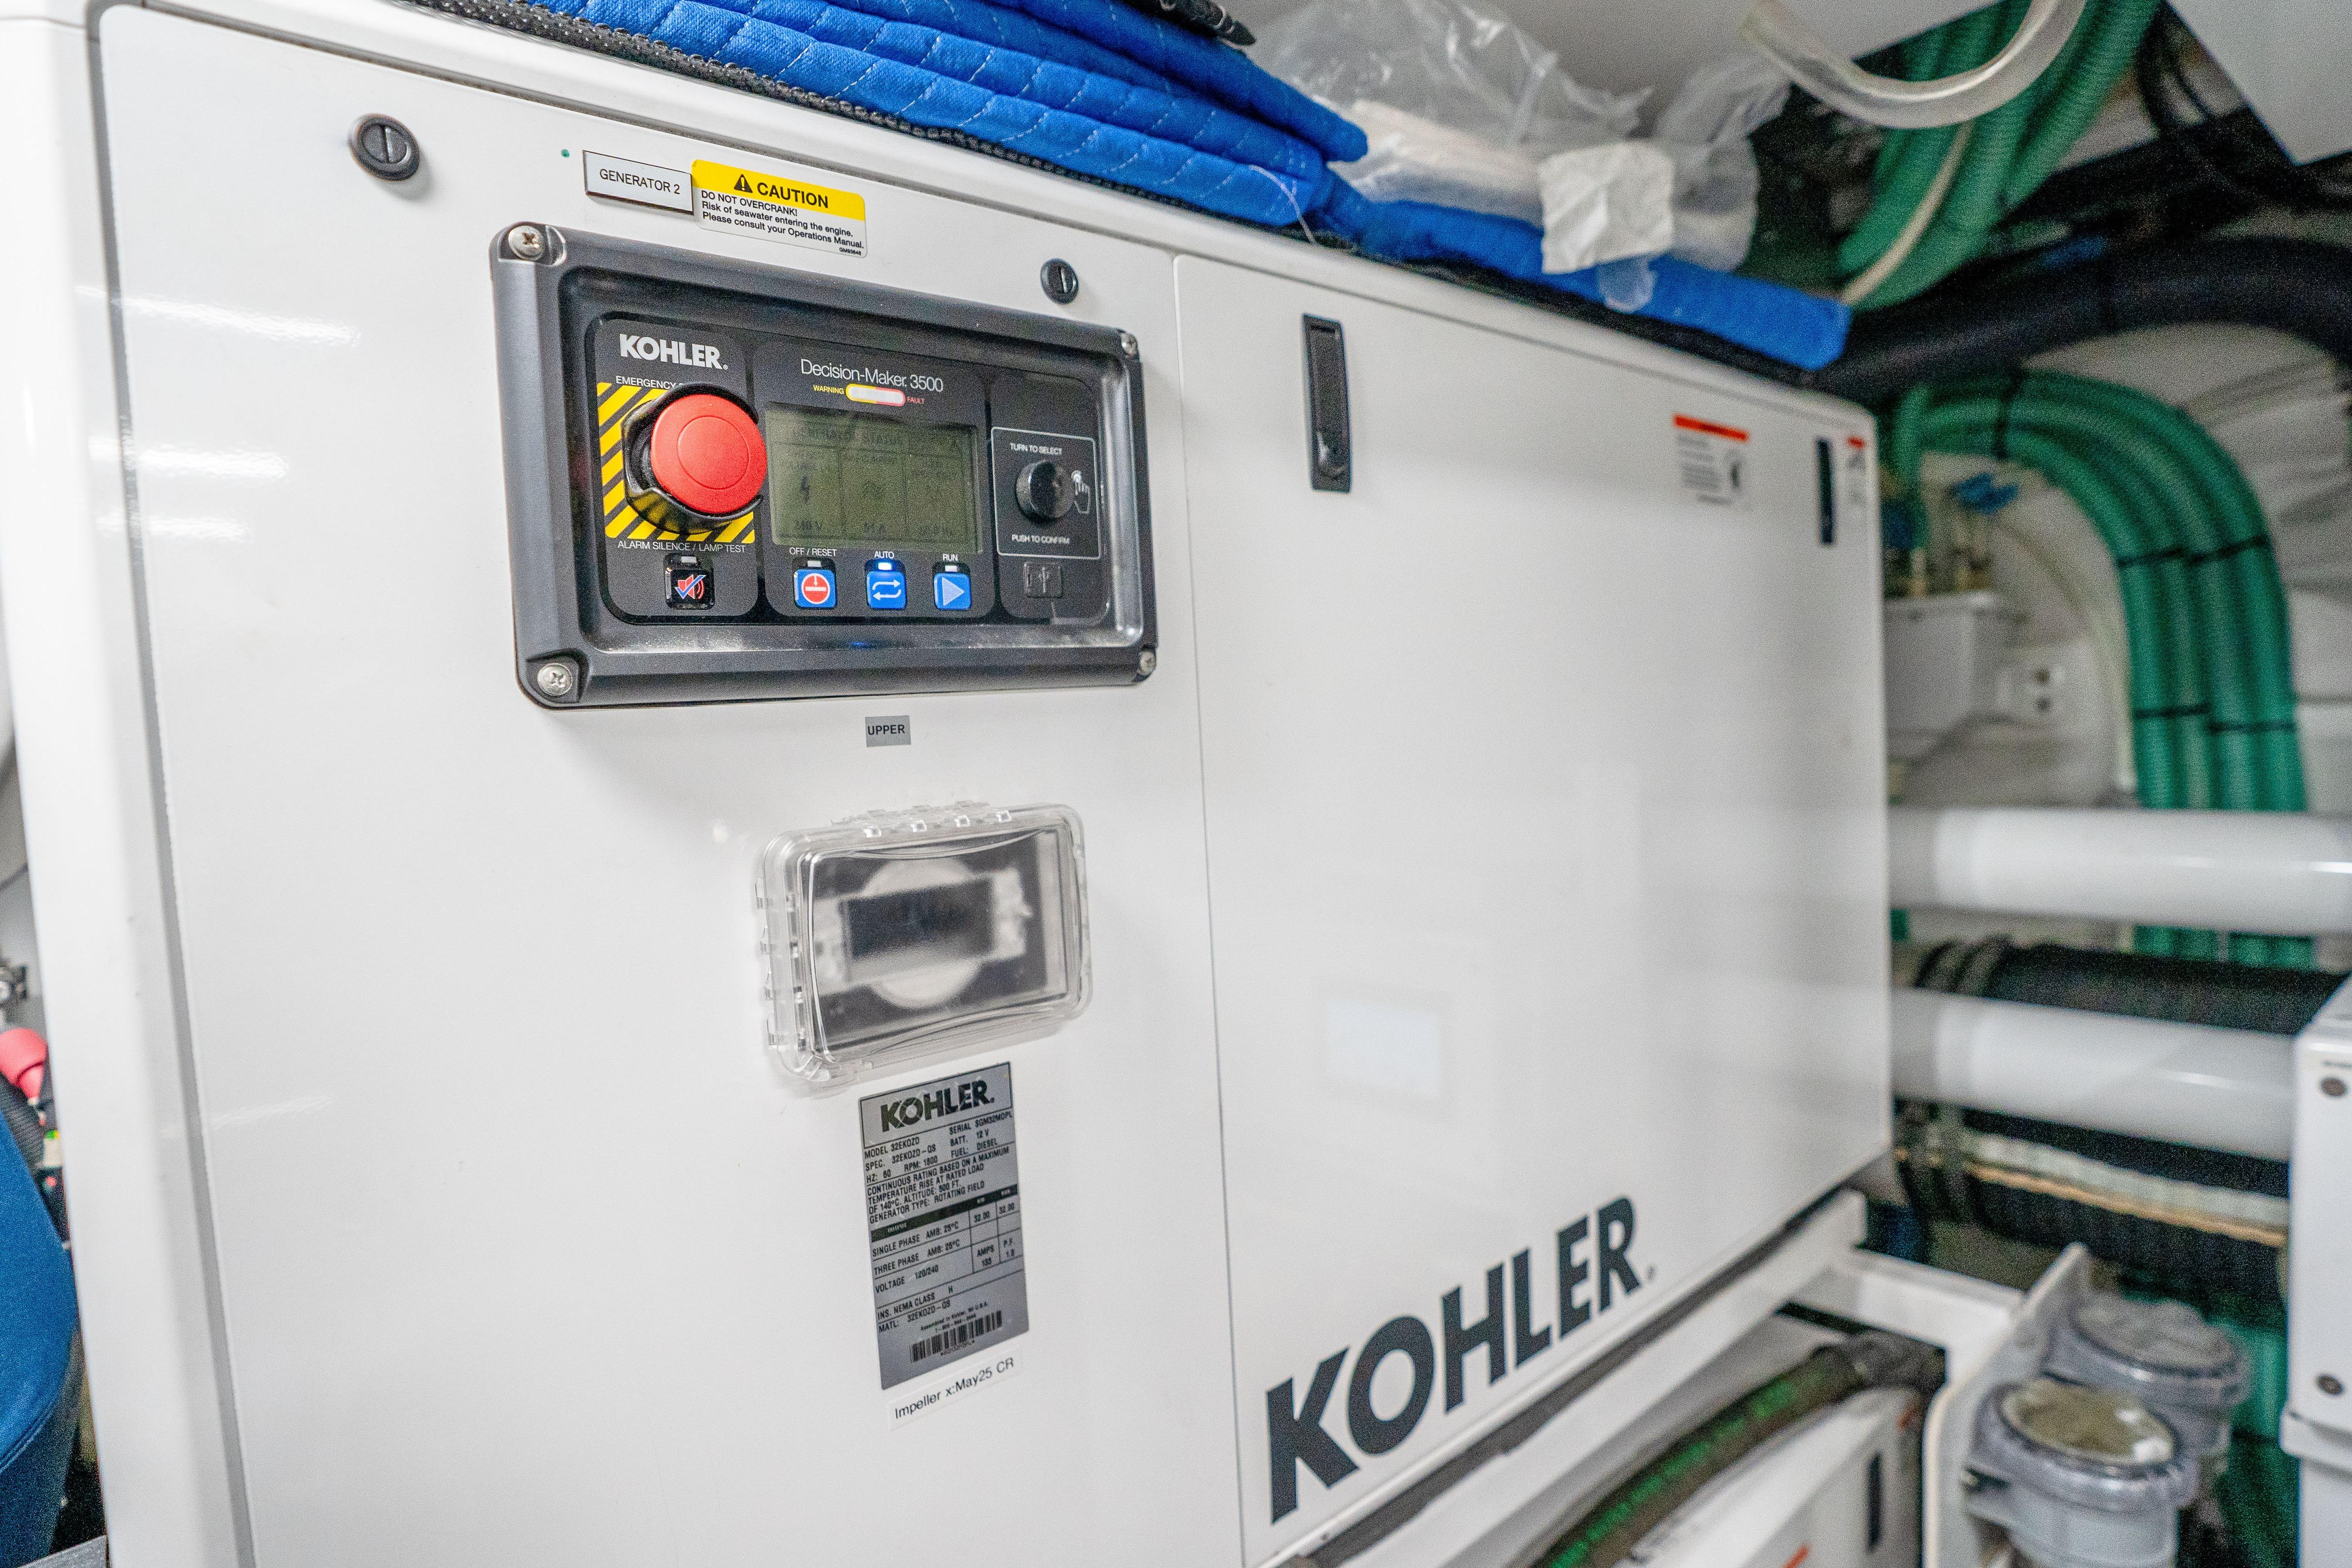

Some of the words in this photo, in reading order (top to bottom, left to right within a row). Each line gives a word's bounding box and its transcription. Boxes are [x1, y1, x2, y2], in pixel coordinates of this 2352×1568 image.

[600, 169, 671, 193] GENERATOR
[674, 184, 680, 194] 2
[701, 190, 715, 200] DO
[718, 193, 737, 204] NOT
[740, 198, 797, 216] OVERCRANK!
[757, 182, 828, 209] CAUTION
[702, 201, 721, 212] Risk
[735, 209, 773, 221] seawater
[775, 216, 808, 229] entering
[810, 222, 823, 231] the
[825, 226, 853, 237] engine.
[703, 211, 732, 224] Please
[734, 218, 765, 230] consult
[767, 225, 785, 235] your
[788, 226, 831, 242] Operations
[835, 237, 864, 249] Manual.
[616, 376, 676, 390] EMERGENCY
[813, 385, 844, 394] WARNING
[910, 374, 943, 393] 3500
[907, 396, 925, 405] FAULT
[1010, 443, 1028, 452] TURN
[1039, 446, 1062, 456] SELECT
[618, 541, 650, 549] ALARM
[653, 542, 690, 551] SILENCE
[699, 543, 723, 552] LAMP
[726, 544, 746, 553] TEST
[1012, 534, 1029, 543] PUSH
[1041, 536, 1070, 544] CONFIRM
[812, 548, 836, 557] RESET
[874, 551, 895, 559] AUTO
[868, 724, 905, 735] UPPER
[949, 1122, 971, 1135] SERIAL
[976, 1130, 983, 1139] 12
[985, 1128, 989, 1137] V
[864, 1145, 888, 1159] MODEL
[951, 1146, 968, 1158] FUEL:
[976, 1137, 997, 1150] DIESEL
[865, 1158, 885, 1171] SPEC.
[866, 1173, 877, 1183] HZ:
[883, 1169, 891, 1178] 60
[904, 1160, 921, 1172] RPM:
[867, 1175, 911, 1196] CONTINUOUS
[913, 1167, 937, 1182] RATING
[939, 1161, 960, 1174] BASED
[961, 1157, 970, 1167] ON
[972, 1155, 977, 1163] A
[978, 1146, 1009, 1162] MAXIMUM
[868, 1183, 916, 1205] TEMPERATURE
[919, 1178, 934, 1189] RISE
[935, 1175, 944, 1184] AT
[946, 1168, 966, 1181] RATED
[967, 1163, 984, 1175] LOAD
[869, 1204, 877, 1215] OF
[903, 1186, 937, 1203] ALTITUDE:
[869, 1204, 909, 1224] GENERATOR
[912, 1198, 930, 1210] TYPE:
[934, 1186, 965, 1203] ROTATING
[967, 1180, 985, 1193] FIELD
[872, 1241, 896, 1257] SINGLE
[898, 1234, 920, 1248] PHASE
[977, 1244, 994, 1257] AMPS
[874, 1261, 895, 1275] THREE
[897, 1253, 919, 1267] PHASE
[875, 1276, 905, 1294] VOLTAGE
[915, 1264, 939, 1280] 120/240
[877, 1308, 891, 1320] INS.
[894, 1300, 913, 1314] NEMA
[915, 1292, 935, 1306] CLASS
[878, 1319, 898, 1333] MATL:
[1266, 1196, 1642, 1525] KOHLER
[895, 1392, 941, 1419] Impeller
[946, 1368, 992, 1397] x:May25
[996, 1357, 1014, 1372] CR
